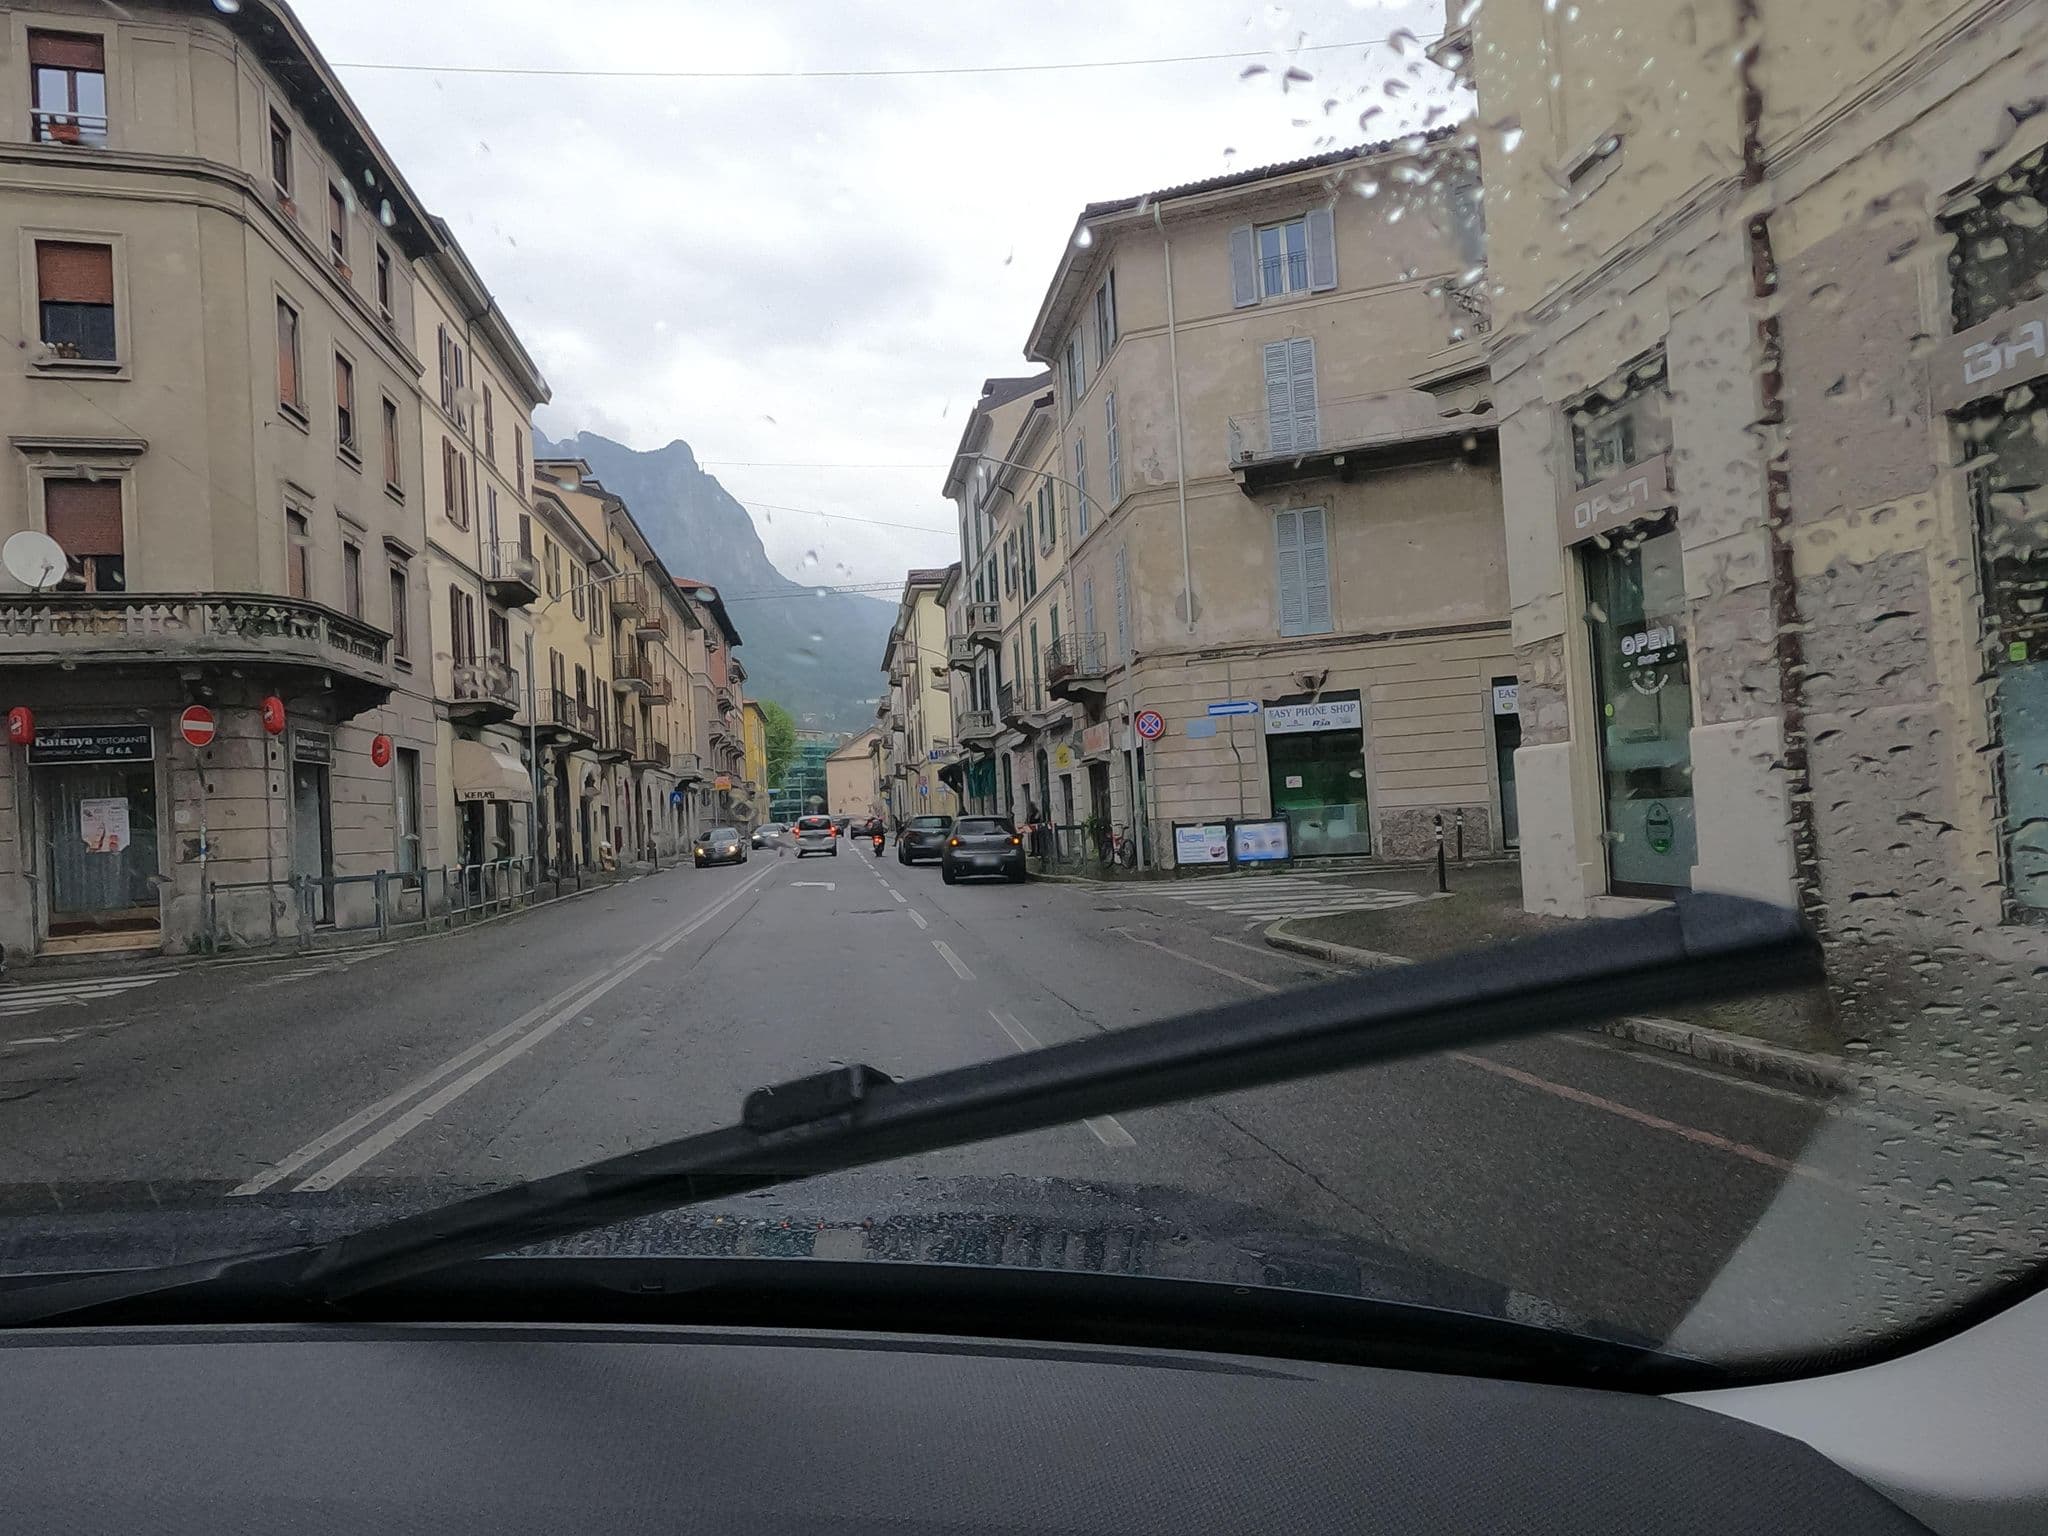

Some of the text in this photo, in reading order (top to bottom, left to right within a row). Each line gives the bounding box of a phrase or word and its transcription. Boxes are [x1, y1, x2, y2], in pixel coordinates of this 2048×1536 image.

[1621, 625, 1676, 656] OPEN
[1498, 689, 1517, 699] EAS
[1269, 703, 1356, 718] EASY PHONE SHOP
[97, 735, 148, 745] RISTORANTE
